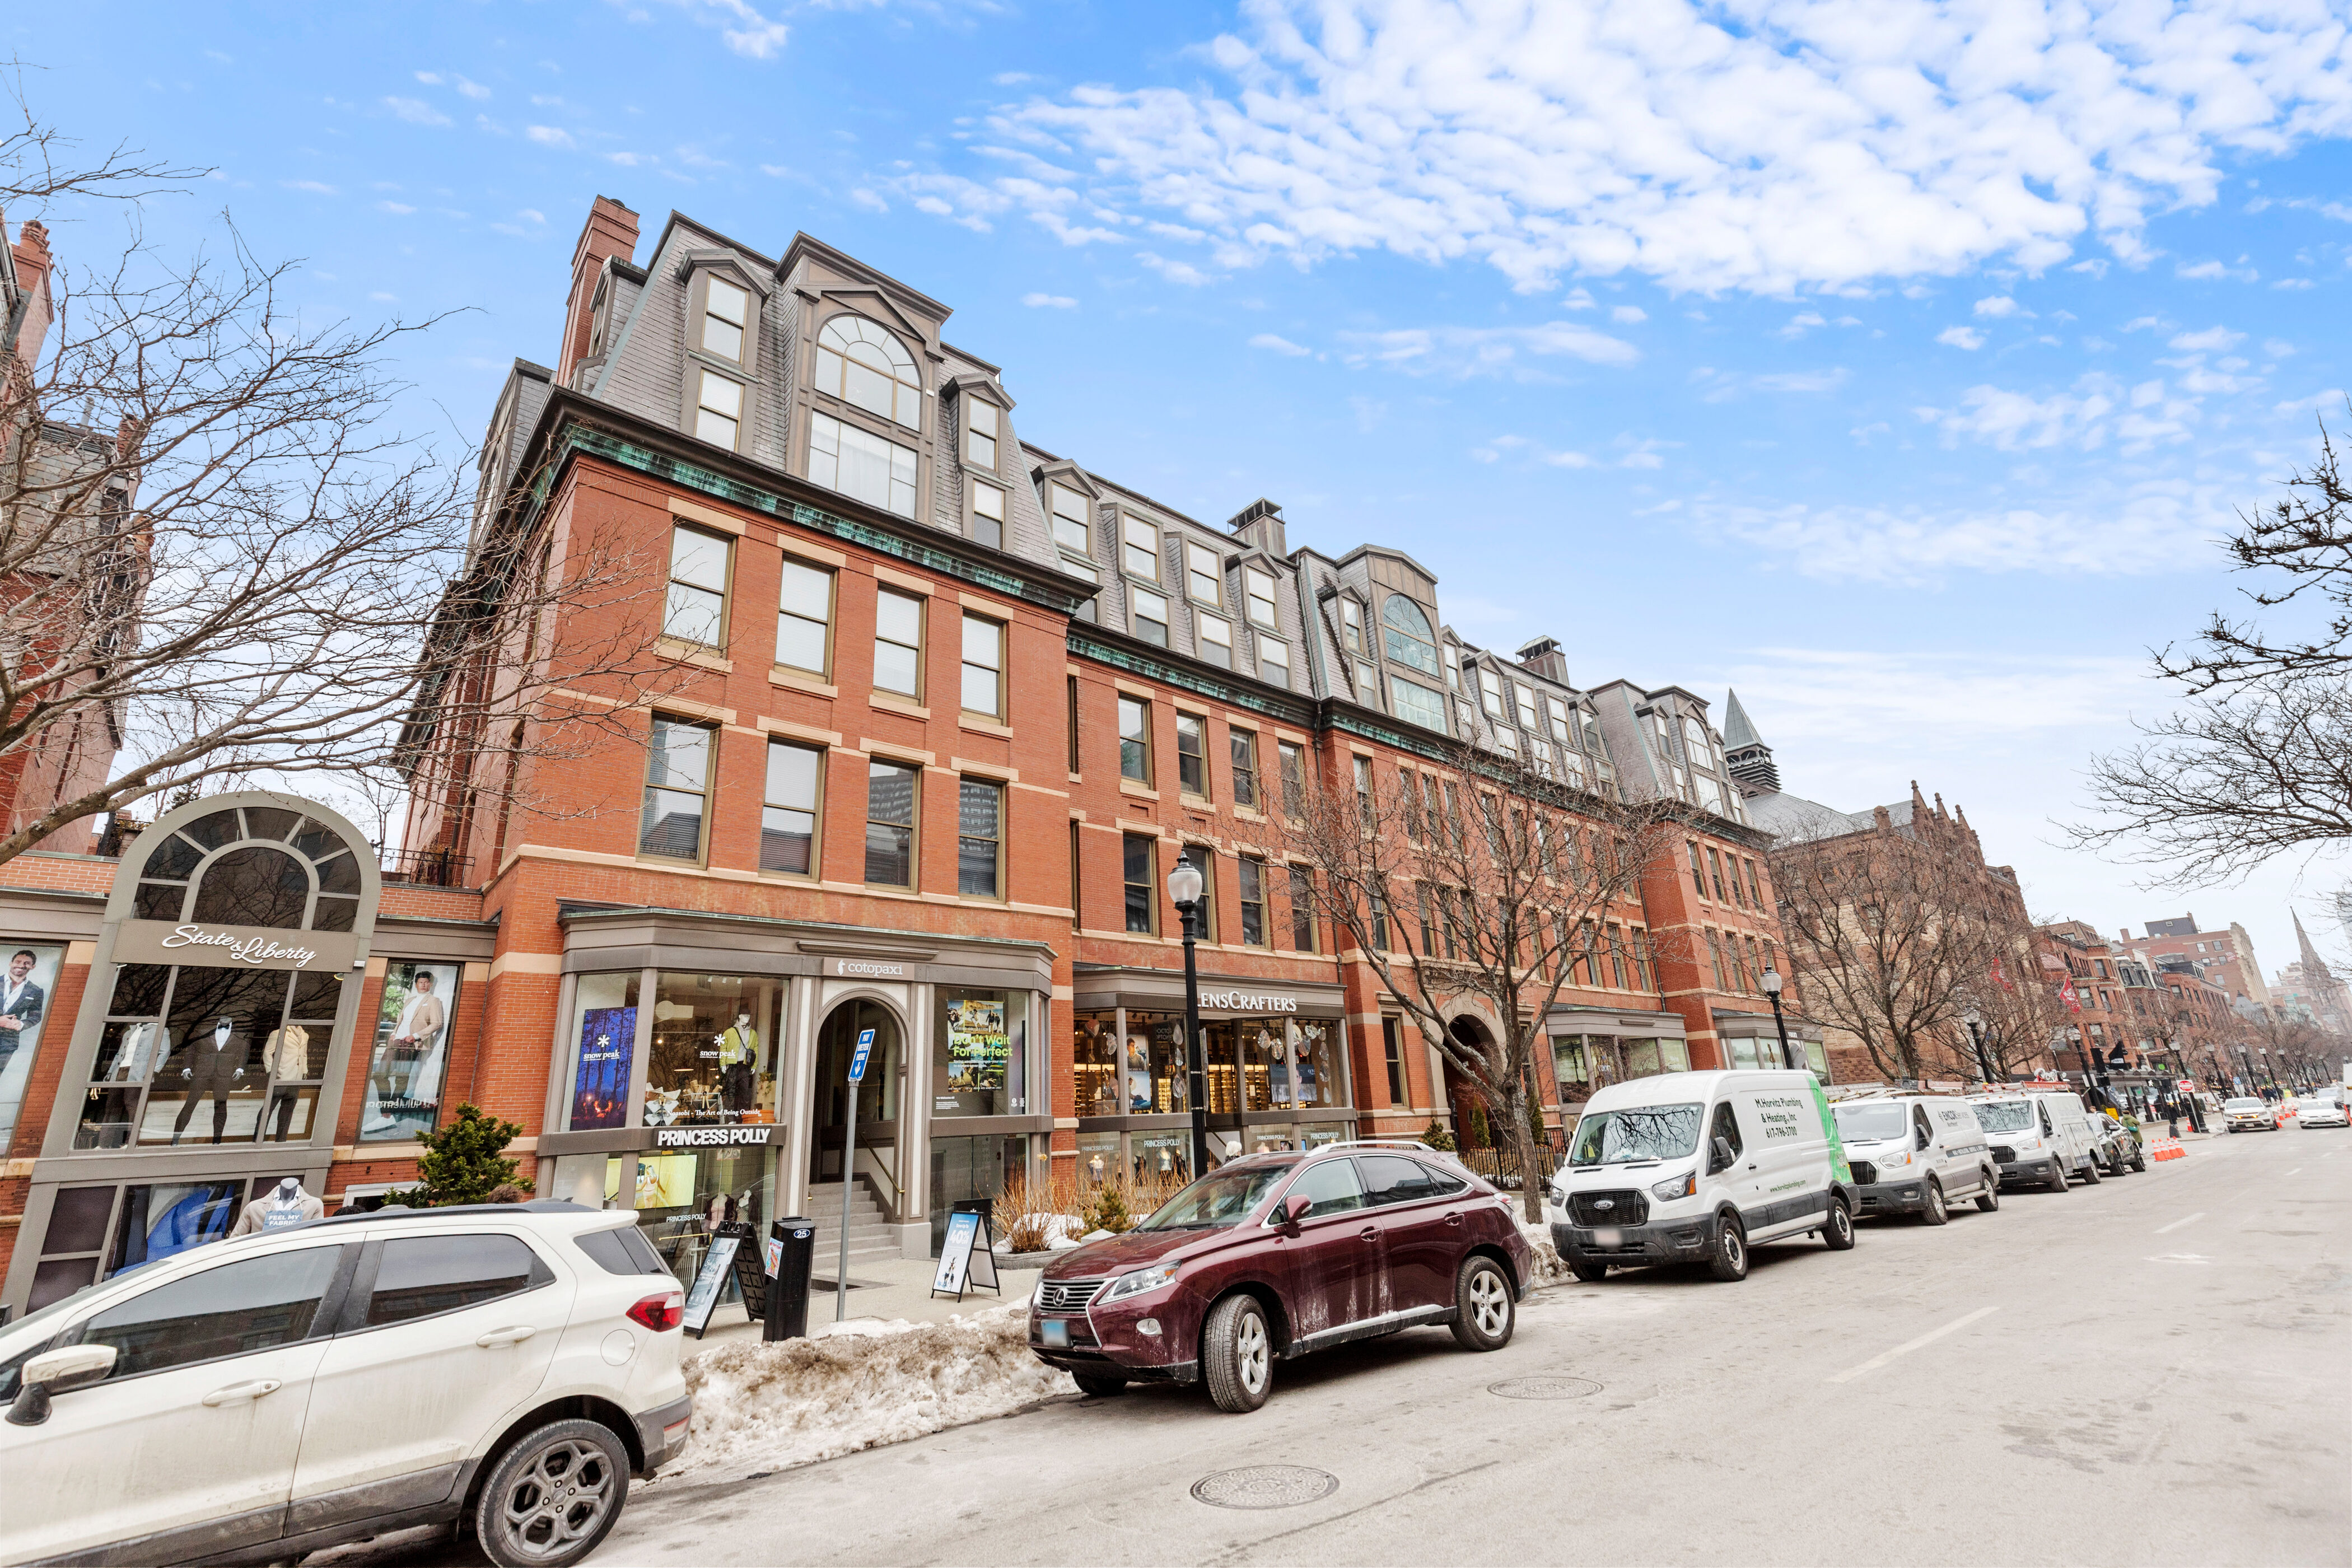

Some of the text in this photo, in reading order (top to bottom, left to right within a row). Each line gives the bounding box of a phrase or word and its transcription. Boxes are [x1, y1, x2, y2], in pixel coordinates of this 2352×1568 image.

[162, 925, 235, 948] State
[230, 937, 317, 968] Liberty
[847, 963, 903, 977] cotopaxi
[954, 1034, 1011, 1045] Don't Wait
[857, 1043, 870, 1052] METER
[954, 1046, 1013, 1057] For Perfect
[602, 1049, 620, 1060] peak
[718, 1049, 736, 1059] peak
[856, 1053, 866, 1061] HERE
[1780, 1098, 1803, 1109] Plumbing
[1761, 1113, 1766, 1123] &
[657, 1128, 771, 1146] PRINCESS POLLY
[1144, 1139, 1166, 1148] PRINCESS
[666, 1215, 692, 1223] PRINCESS
